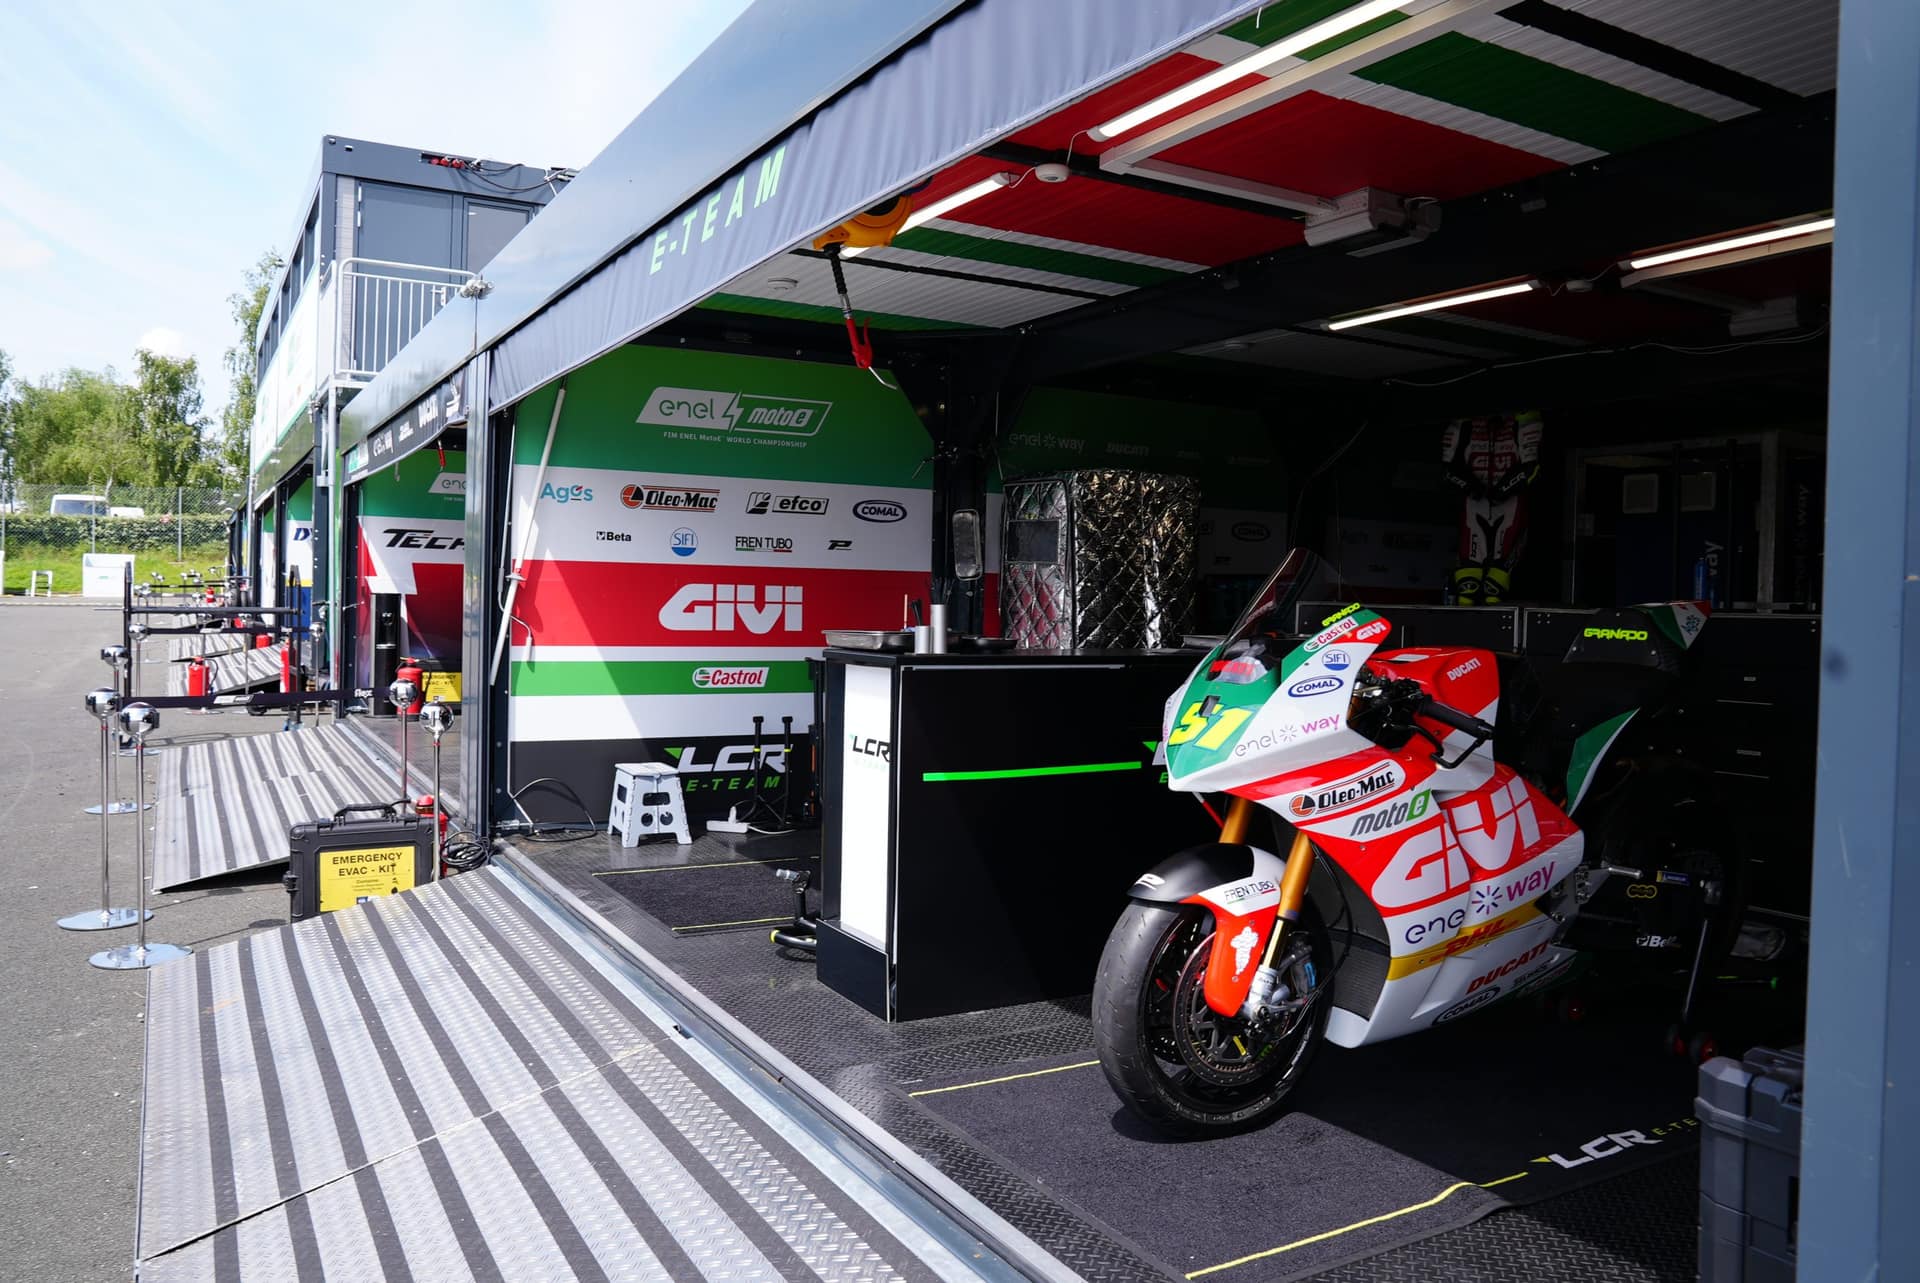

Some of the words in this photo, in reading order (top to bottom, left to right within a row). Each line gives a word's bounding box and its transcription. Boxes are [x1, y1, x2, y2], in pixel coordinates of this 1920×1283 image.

[650, 146, 786, 275] E-TEAM
[659, 398, 715, 420] enel
[727, 436, 751, 445] WORLD
[753, 438, 808, 449] CHAMPIONSHIP
[540, 482, 593, 504] Agos
[779, 495, 822, 512] efco
[861, 505, 900, 517] COMAL
[606, 531, 632, 542] Beta
[673, 532, 695, 546] SIFI
[735, 536, 763, 548] FREN
[765, 537, 793, 550] TUBO
[658, 583, 803, 635] GIVI
[1317, 617, 1356, 645] Castrol
[1325, 653, 1346, 664] SIFI
[1446, 657, 1482, 681] DUCATI
[711, 669, 763, 685] Castrol
[1296, 680, 1336, 694] COMAL
[1168, 701, 1254, 751] 51
[1235, 734, 1277, 757] enel
[1301, 714, 1340, 735] way
[677, 744, 794, 774] LCR
[1371, 775, 1541, 908] GIVI
[332, 851, 402, 865] EMERGENCY
[338, 866, 367, 877] EVAC
[379, 863, 396, 874] KIT
[1224, 886, 1250, 901] FREN
[1251, 880, 1275, 894] TUBO
[1405, 908, 1466, 944] ene
[1506, 861, 1556, 901] way
[1465, 939, 1550, 995] DUCATI
[1547, 1129, 1664, 1169] LCR
[1651, 1117, 1699, 1136] E-TE
